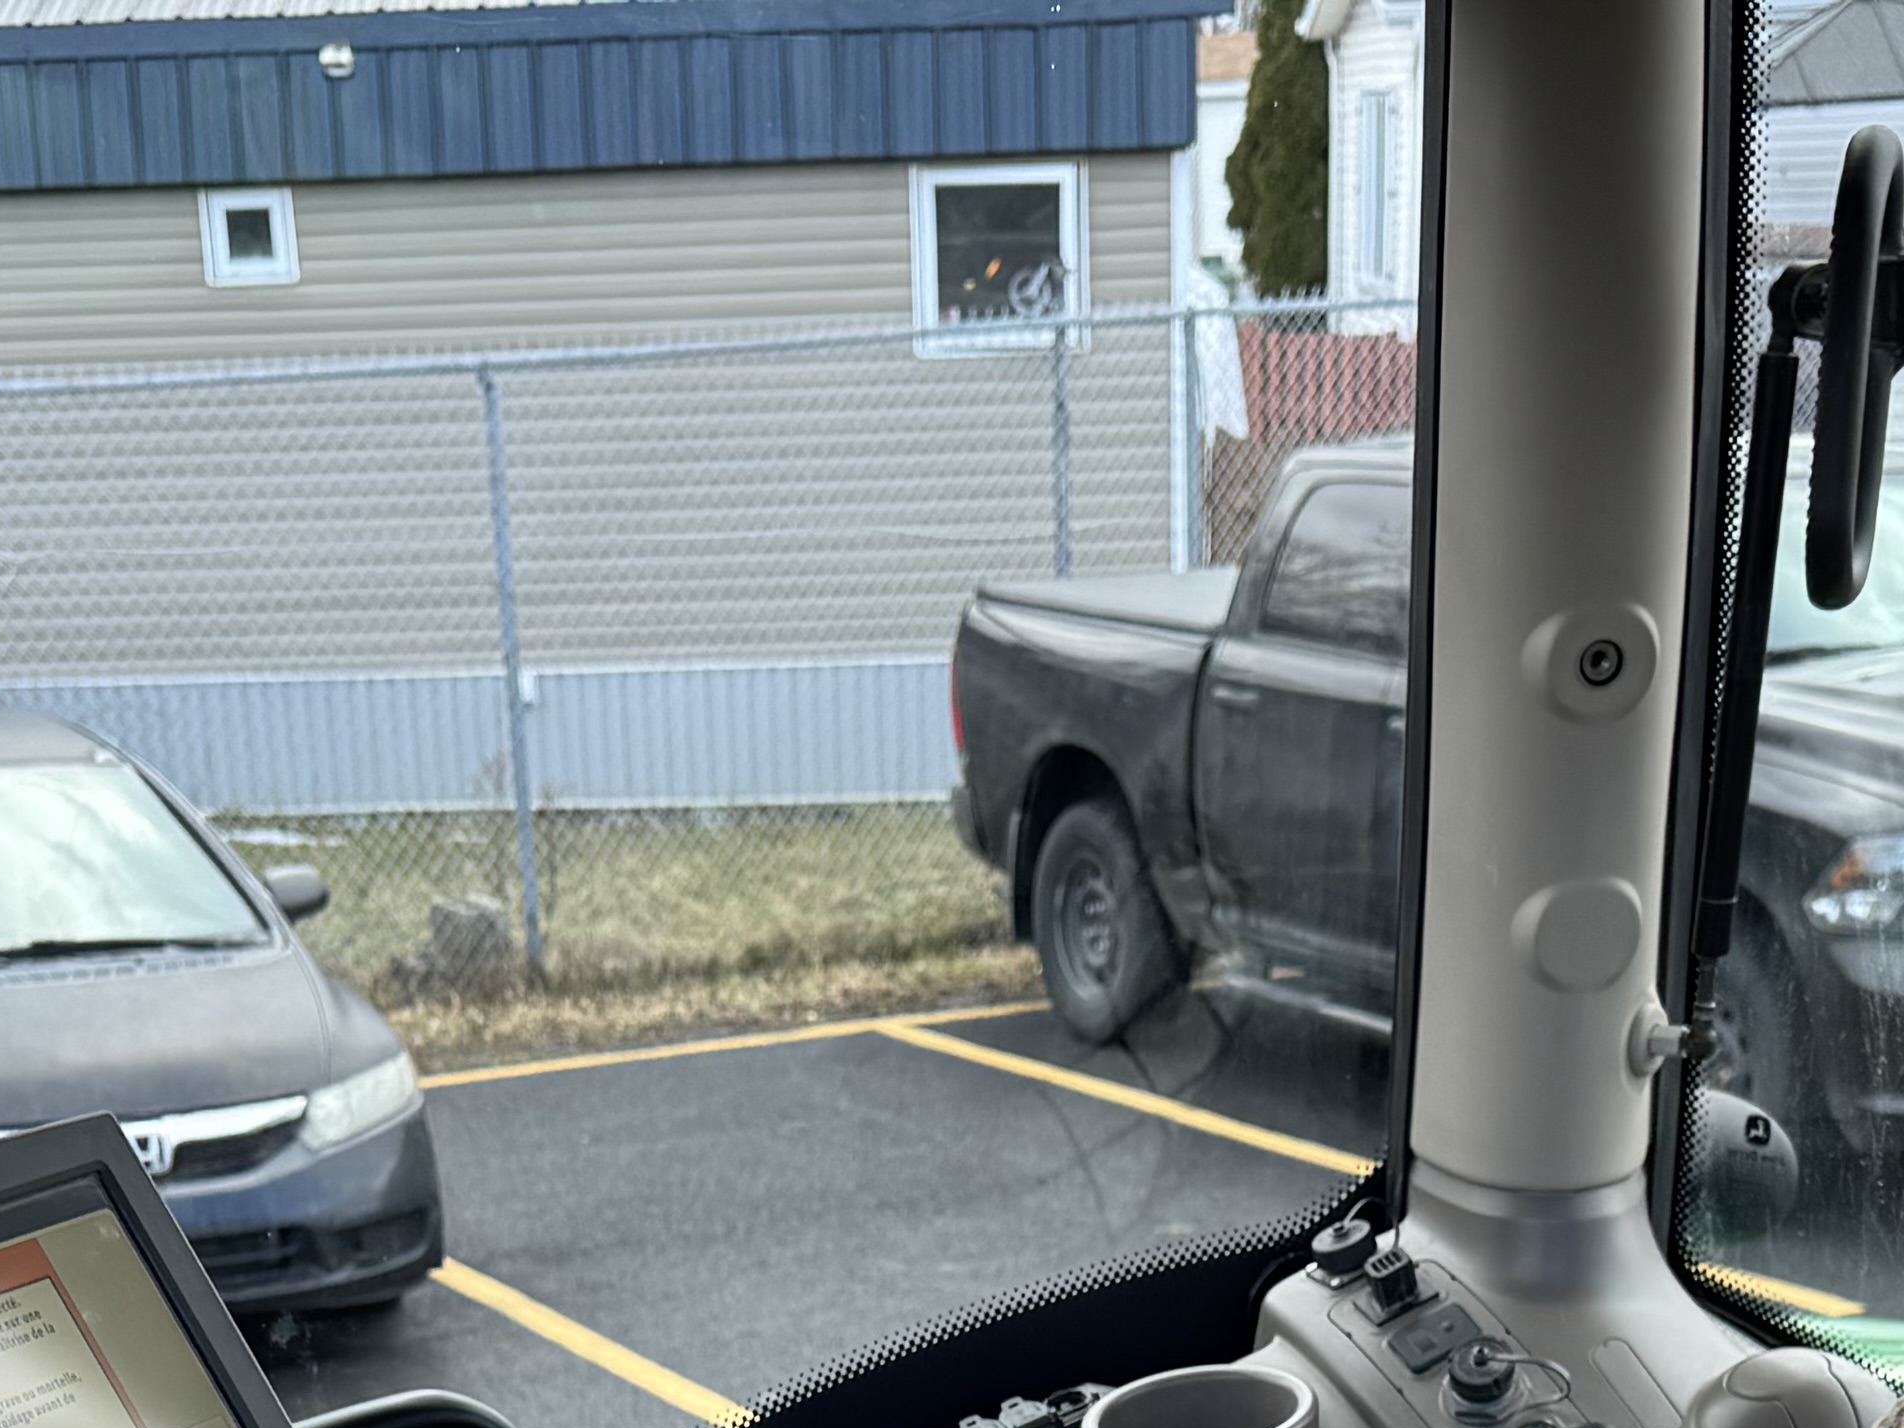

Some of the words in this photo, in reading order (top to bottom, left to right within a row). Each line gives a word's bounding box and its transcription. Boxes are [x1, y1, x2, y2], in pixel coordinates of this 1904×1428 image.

[4, 1317, 19, 1328] sur
[31, 1328, 43, 1338] de
[43, 1323, 55, 1333] la
